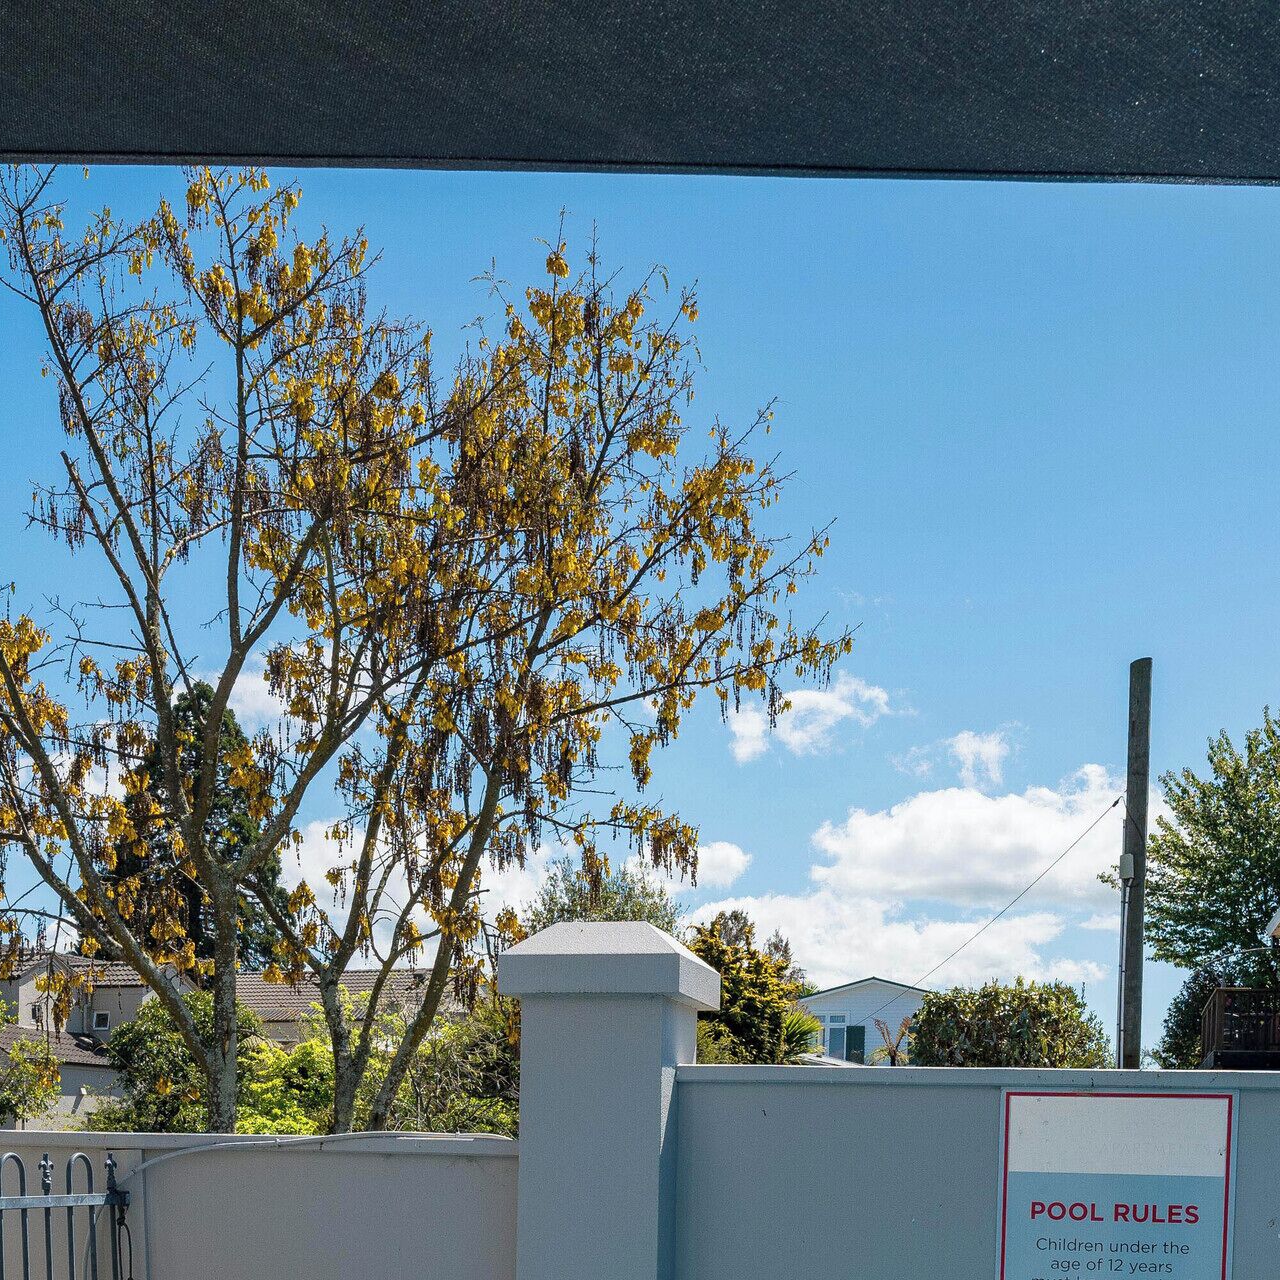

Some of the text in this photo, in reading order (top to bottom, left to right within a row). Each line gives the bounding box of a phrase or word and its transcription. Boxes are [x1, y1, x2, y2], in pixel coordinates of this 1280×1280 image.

[1030, 1201, 1200, 1225] POOL RULES
[1035, 1237, 1190, 1255] Children under the
[1050, 1258, 1173, 1275] age of 12 years
